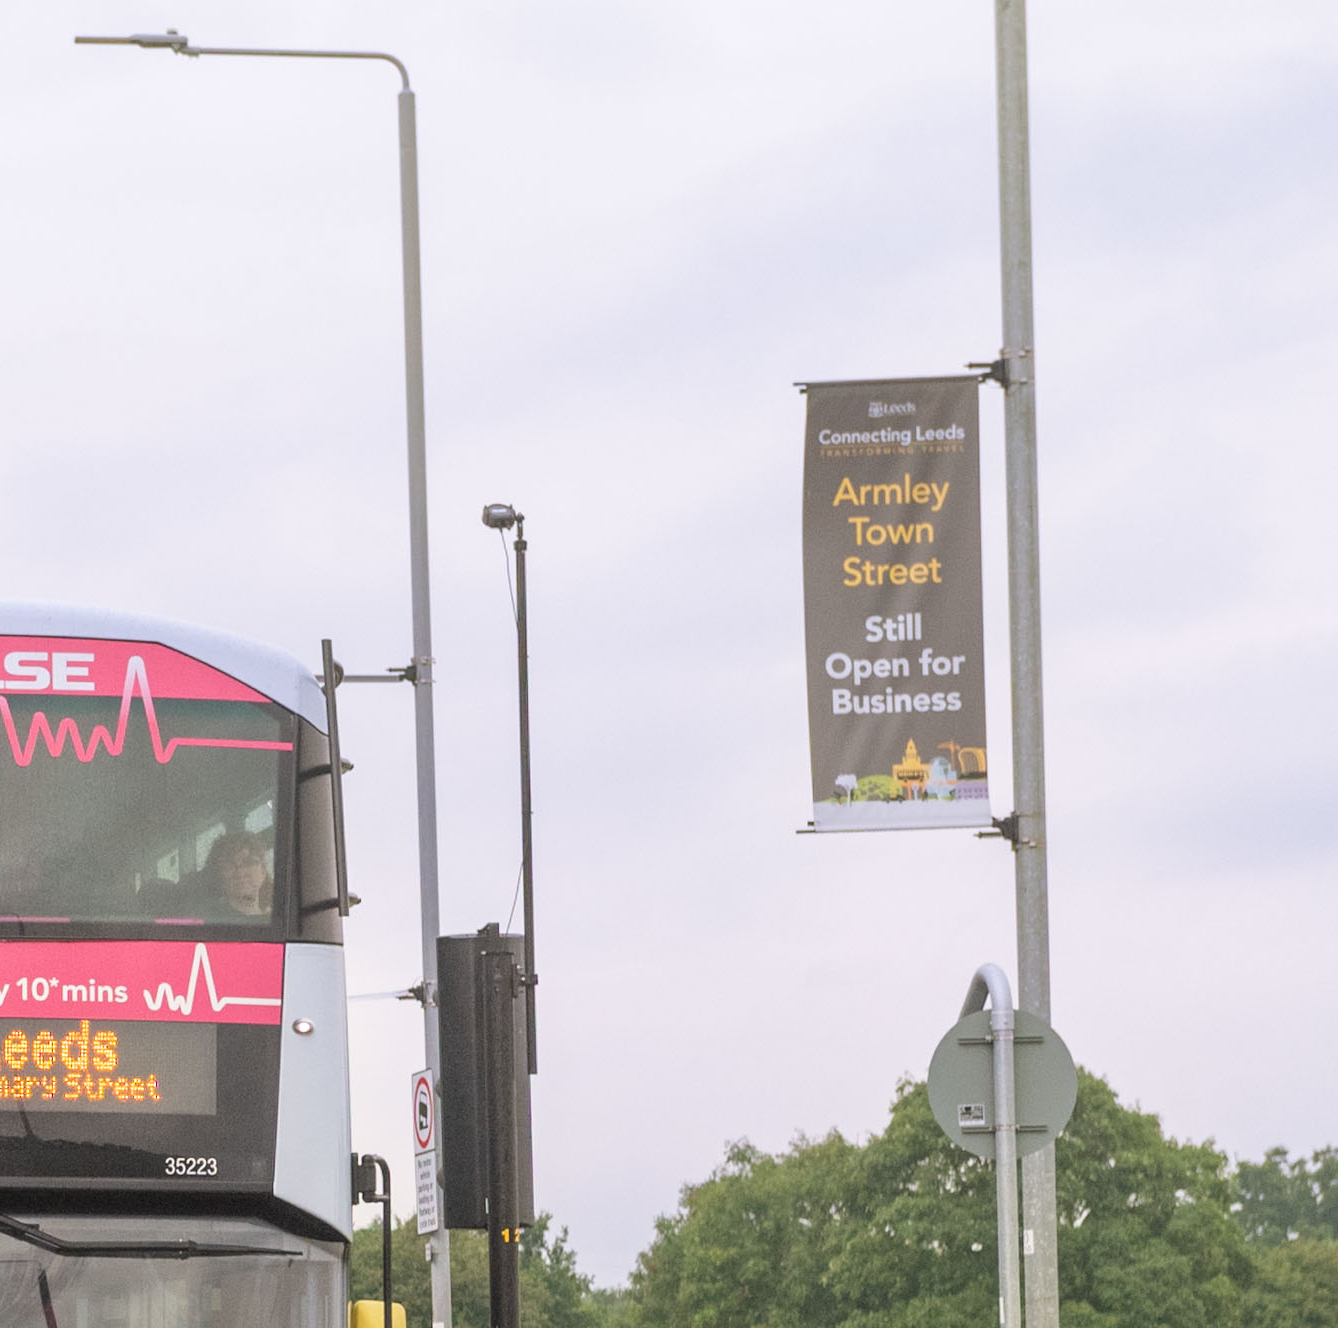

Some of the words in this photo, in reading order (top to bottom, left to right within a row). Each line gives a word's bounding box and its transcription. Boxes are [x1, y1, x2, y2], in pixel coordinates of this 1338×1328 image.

[818, 427, 911, 447] Connecting
[916, 424, 966, 441] Leeds
[832, 472, 950, 512] Armley
[848, 516, 935, 546] Town
[843, 556, 943, 587] Street
[865, 612, 922, 643] Still
[825, 652, 910, 686] Open
[918, 647, 966, 676] for
[832, 687, 962, 715] Business
[62, 1073, 162, 1101] Street
[164, 1156, 218, 1176] 35223
